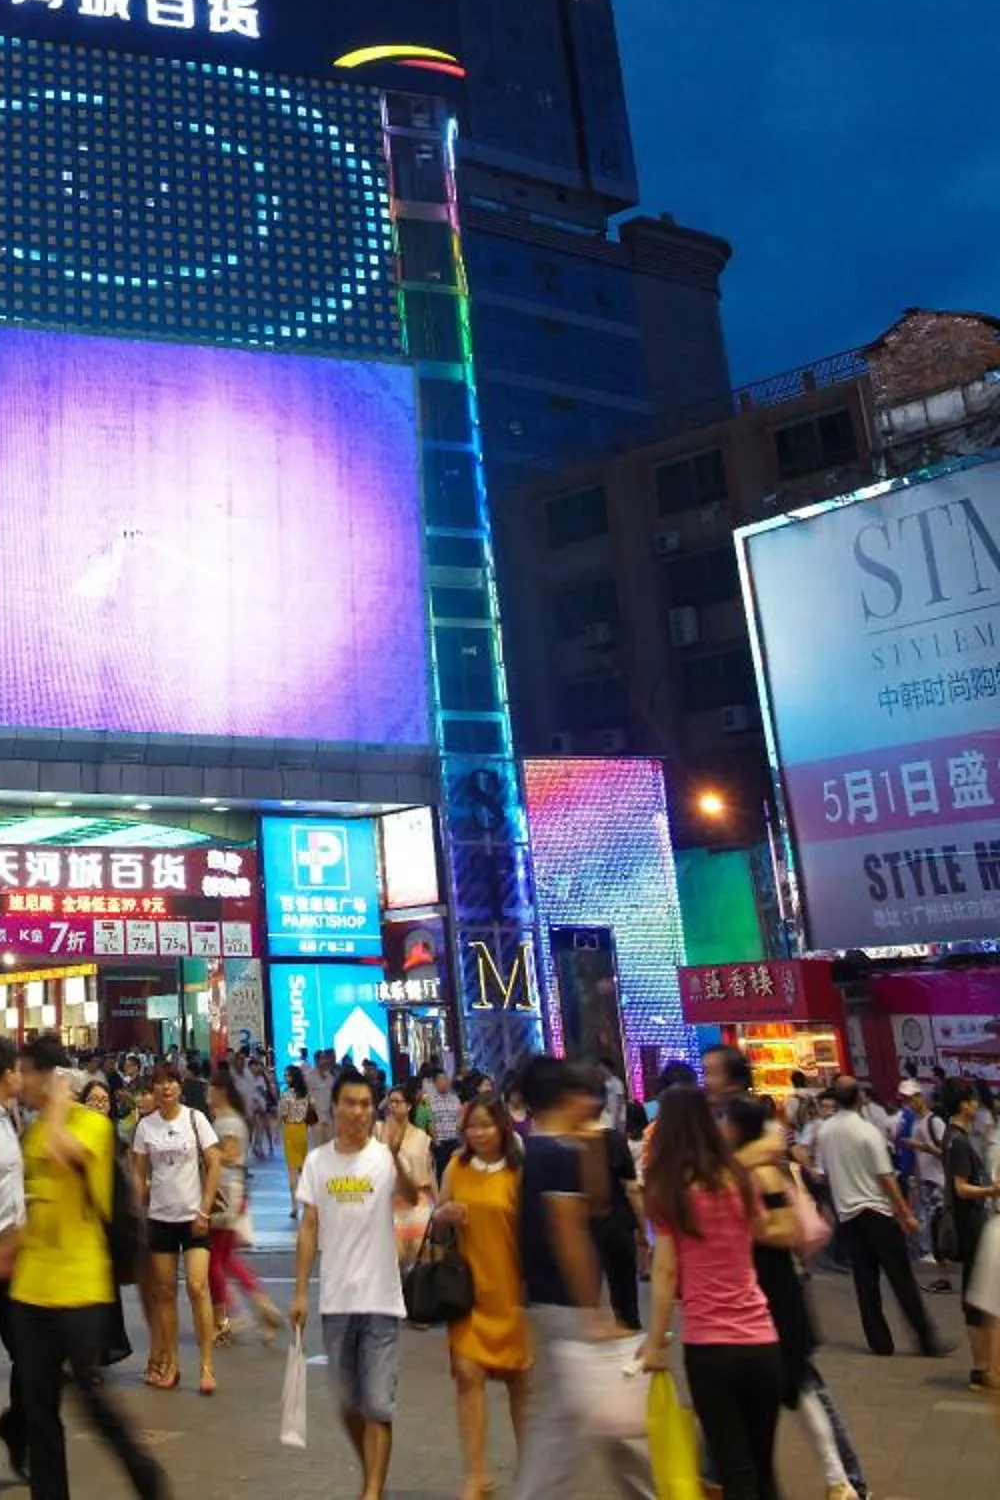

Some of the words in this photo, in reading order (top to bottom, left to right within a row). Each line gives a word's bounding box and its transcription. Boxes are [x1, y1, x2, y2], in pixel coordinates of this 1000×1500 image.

[878, 663, 1000, 716] 中韩时尚购
[823, 750, 1000, 825] 5月1日盛
[863, 844, 967, 902] STYLE
